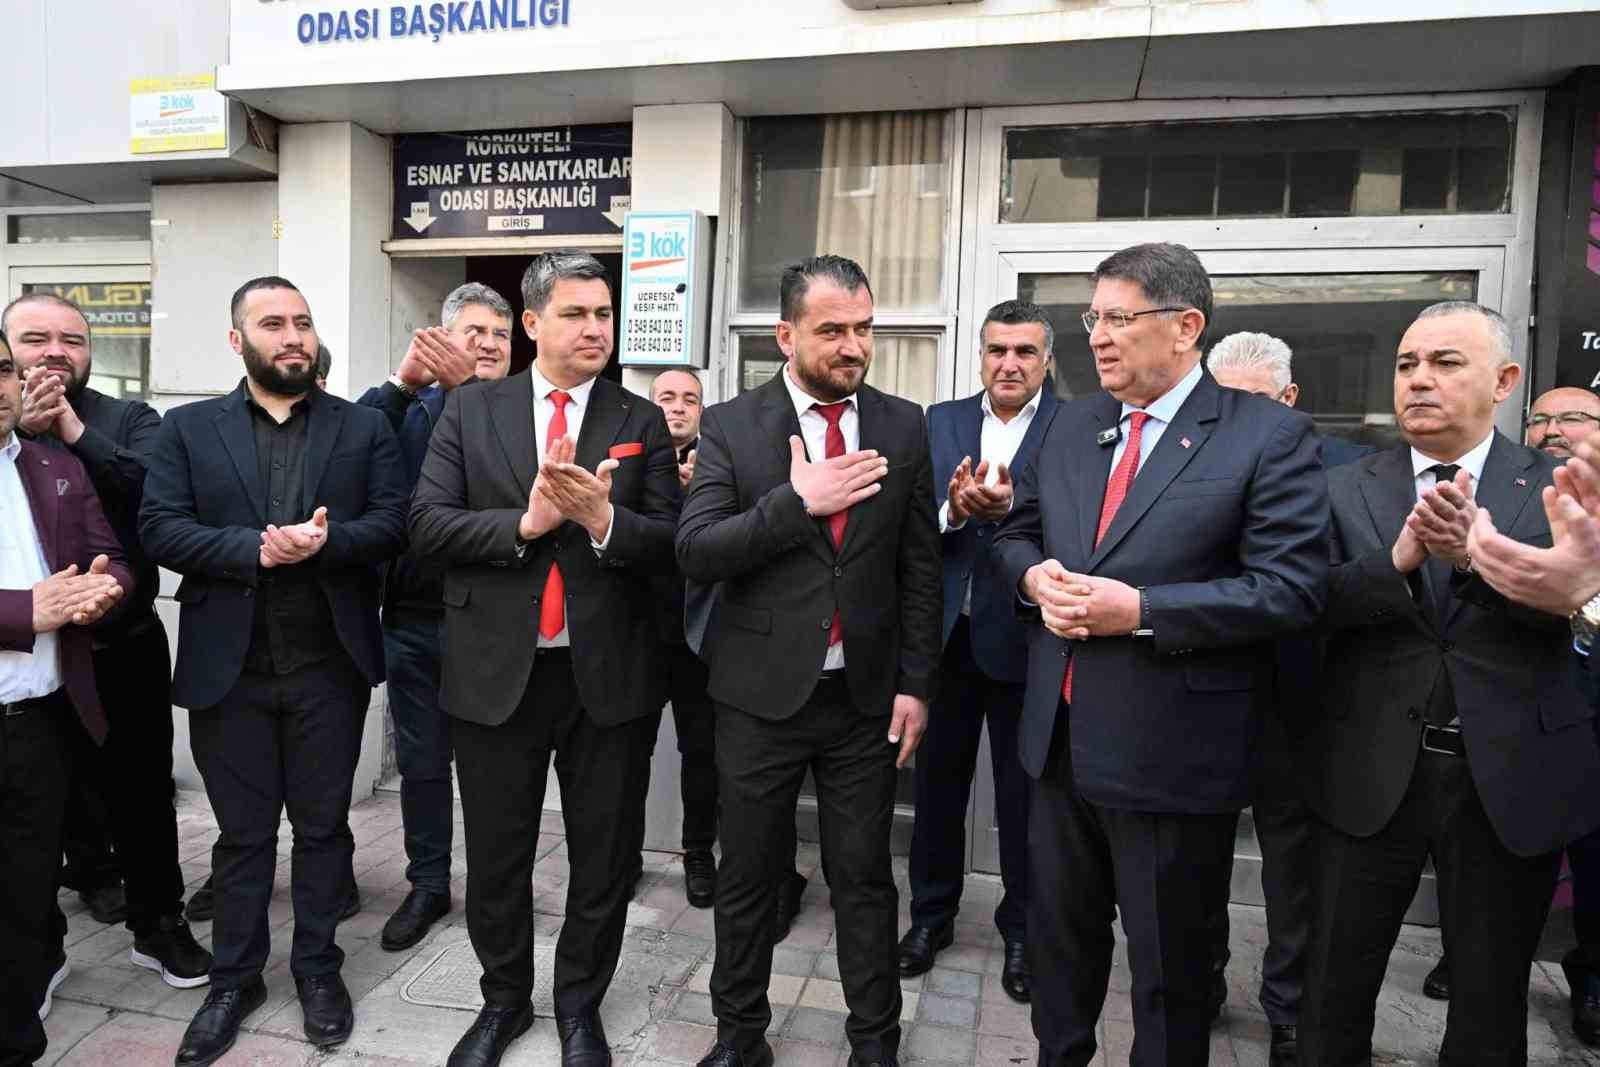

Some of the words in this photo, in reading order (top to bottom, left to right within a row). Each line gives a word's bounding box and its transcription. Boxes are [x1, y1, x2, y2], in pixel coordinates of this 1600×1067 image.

[296, 8, 380, 44] ODASI
[407, 164, 464, 186] ESNAF
[469, 162, 492, 184] VE
[497, 157, 632, 183] SANATKARLAR
[440, 190, 489, 211] ODASI
[493, 181, 597, 214] BAŞKANLIĞI
[630, 231, 646, 258] 3
[650, 231, 686, 258] kök
